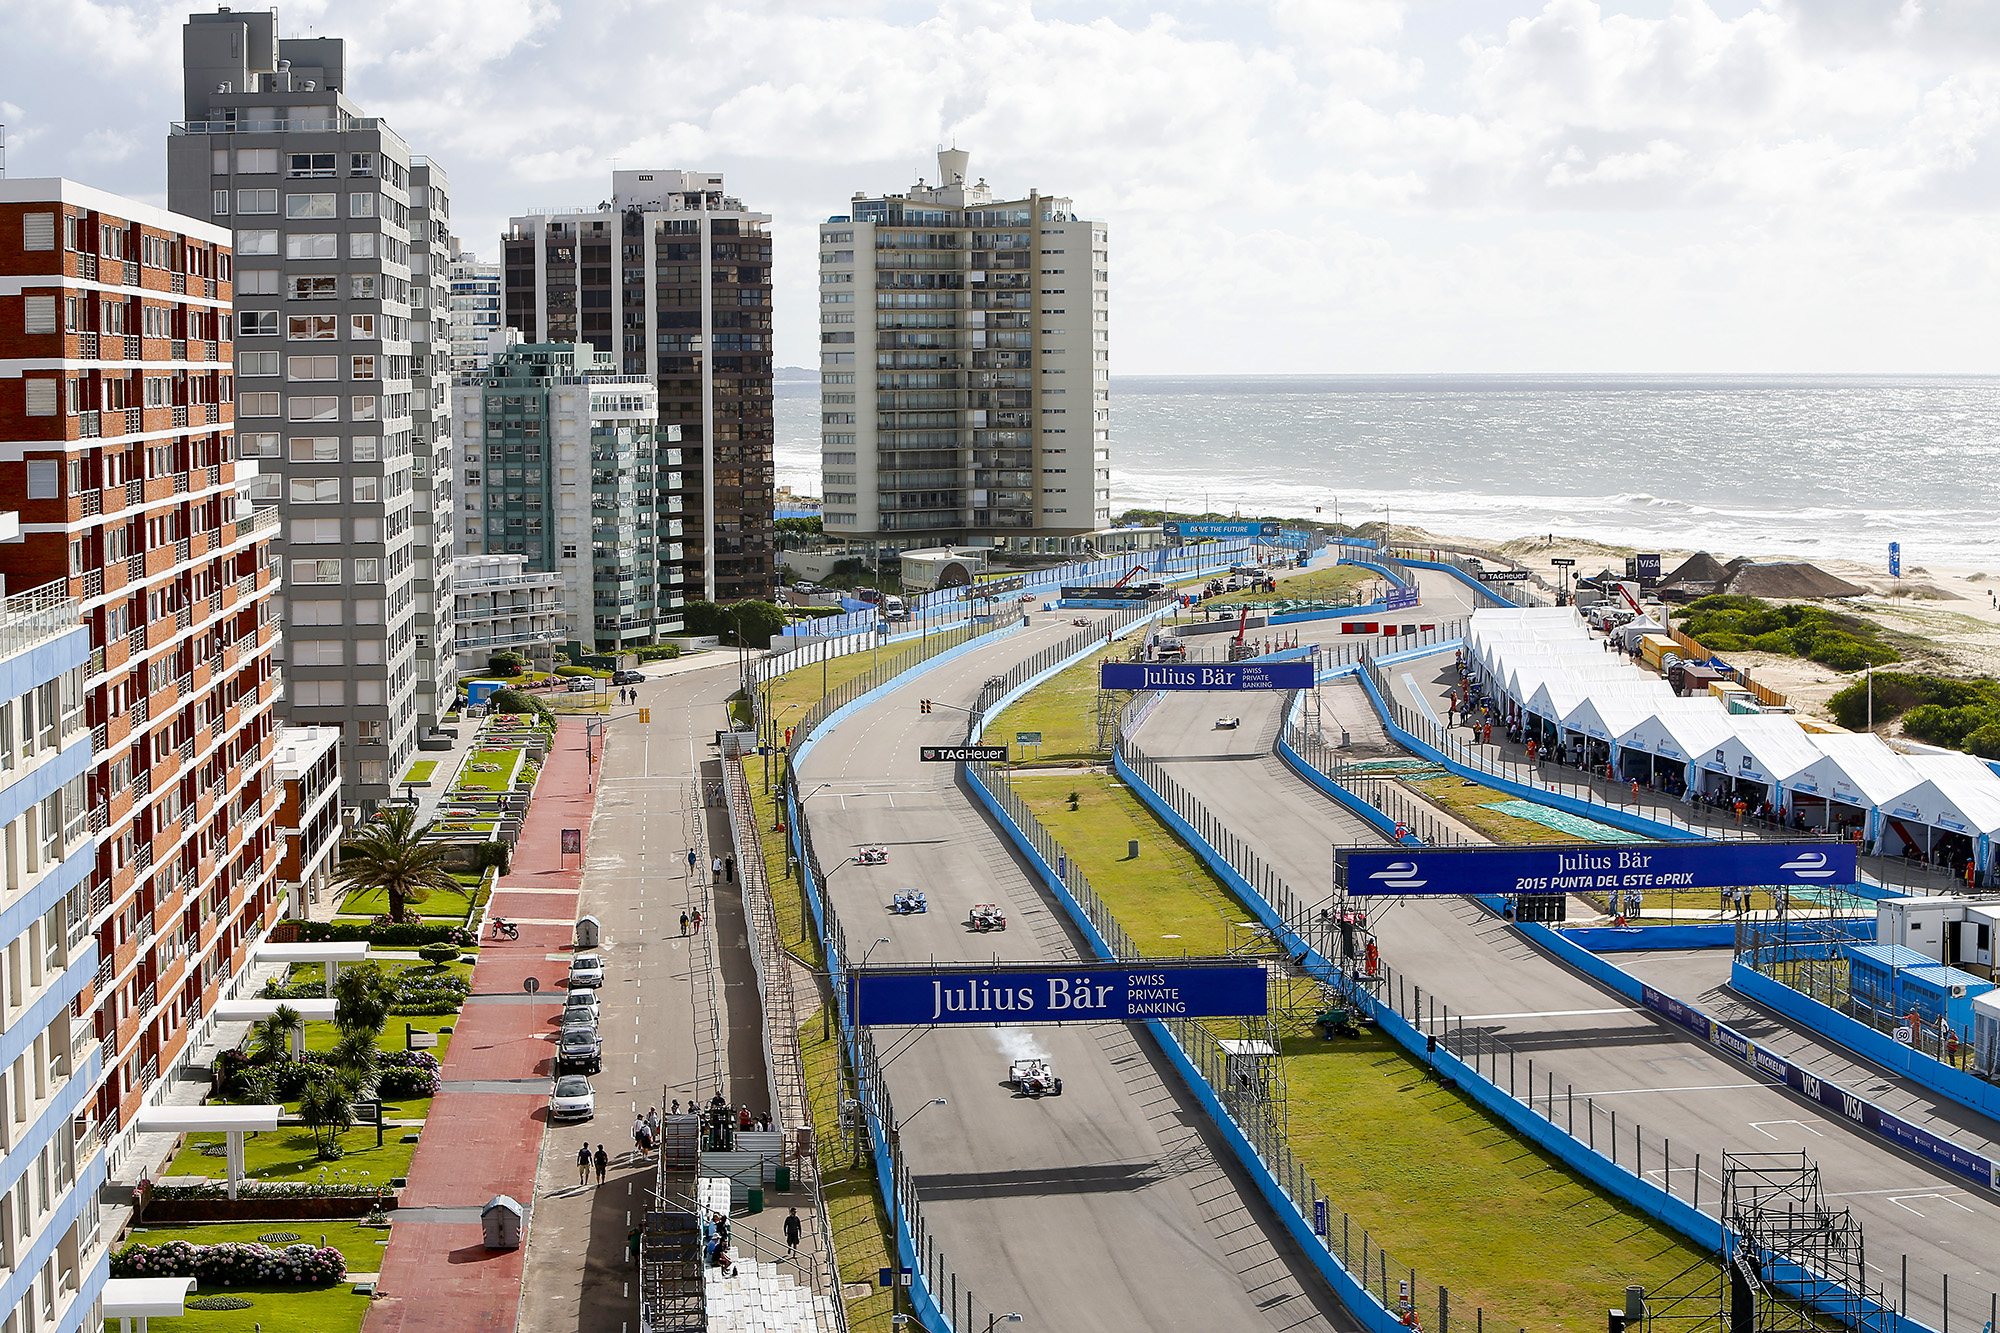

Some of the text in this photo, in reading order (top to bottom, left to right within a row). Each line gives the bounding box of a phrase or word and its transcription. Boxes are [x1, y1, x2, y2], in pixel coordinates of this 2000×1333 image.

[1639, 559, 1660, 568] VISA
[1143, 667, 1236, 688] Julius Bär
[938, 749, 1004, 760] TAGHeuer
[1558, 851, 1652, 874] Julius Bär
[1515, 872, 1694, 890] 2015 PUNTA DEL ESTE ePRIX
[1128, 974, 1165, 987] SWISS
[932, 977, 1114, 1020] Julius Bär
[1128, 988, 1179, 1001] PRIVATE
[1128, 1001, 1186, 1015] BANKING
[1721, 1031, 1747, 1054] MICHELIN
[1898, 1031, 1908, 1039] 50
[1757, 1053, 1786, 1076] MICHELIN
[1800, 1072, 1821, 1101] VISA
[1841, 1093, 1863, 1123] VISA
[1400, 1284, 1407, 1293] F
